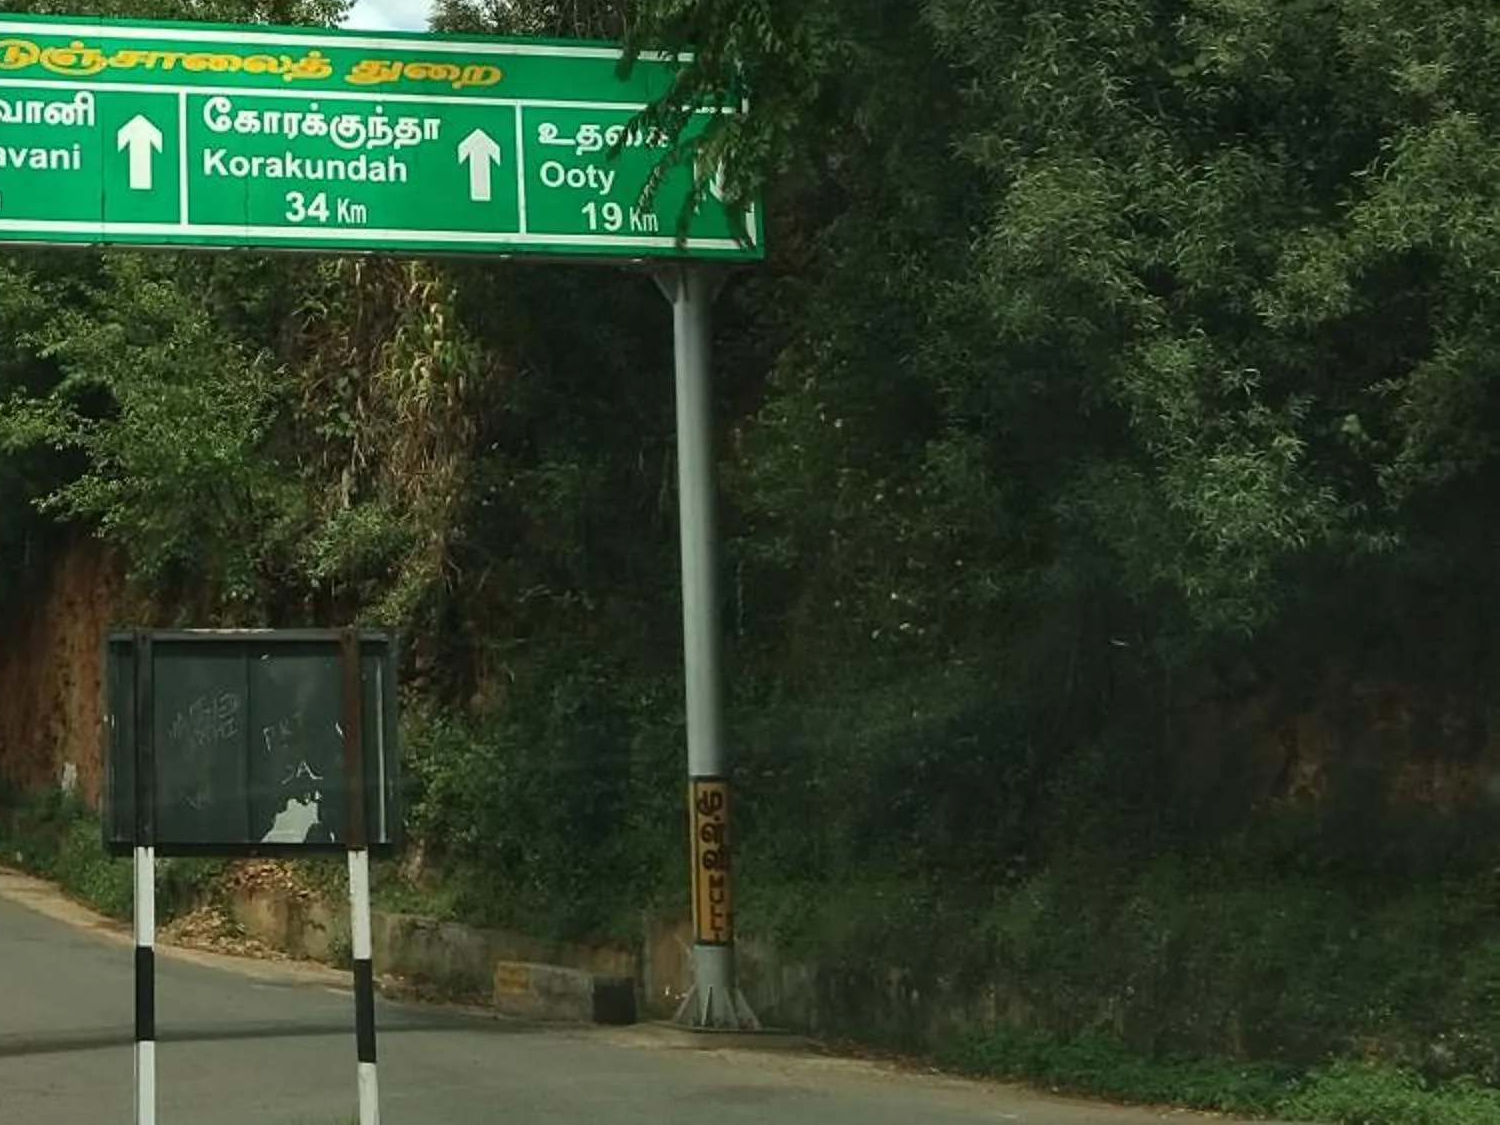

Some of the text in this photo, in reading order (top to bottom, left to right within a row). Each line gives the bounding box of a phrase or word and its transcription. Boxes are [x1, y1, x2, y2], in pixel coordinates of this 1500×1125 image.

[345, 58, 505, 89] துறை
[202, 95, 442, 150] கோரக்குந்தா
[203, 147, 409, 184] Korakundah
[540, 161, 615, 195] Ooty
[285, 191, 367, 224] 34 Km
[581, 202, 659, 232] 19 Km
